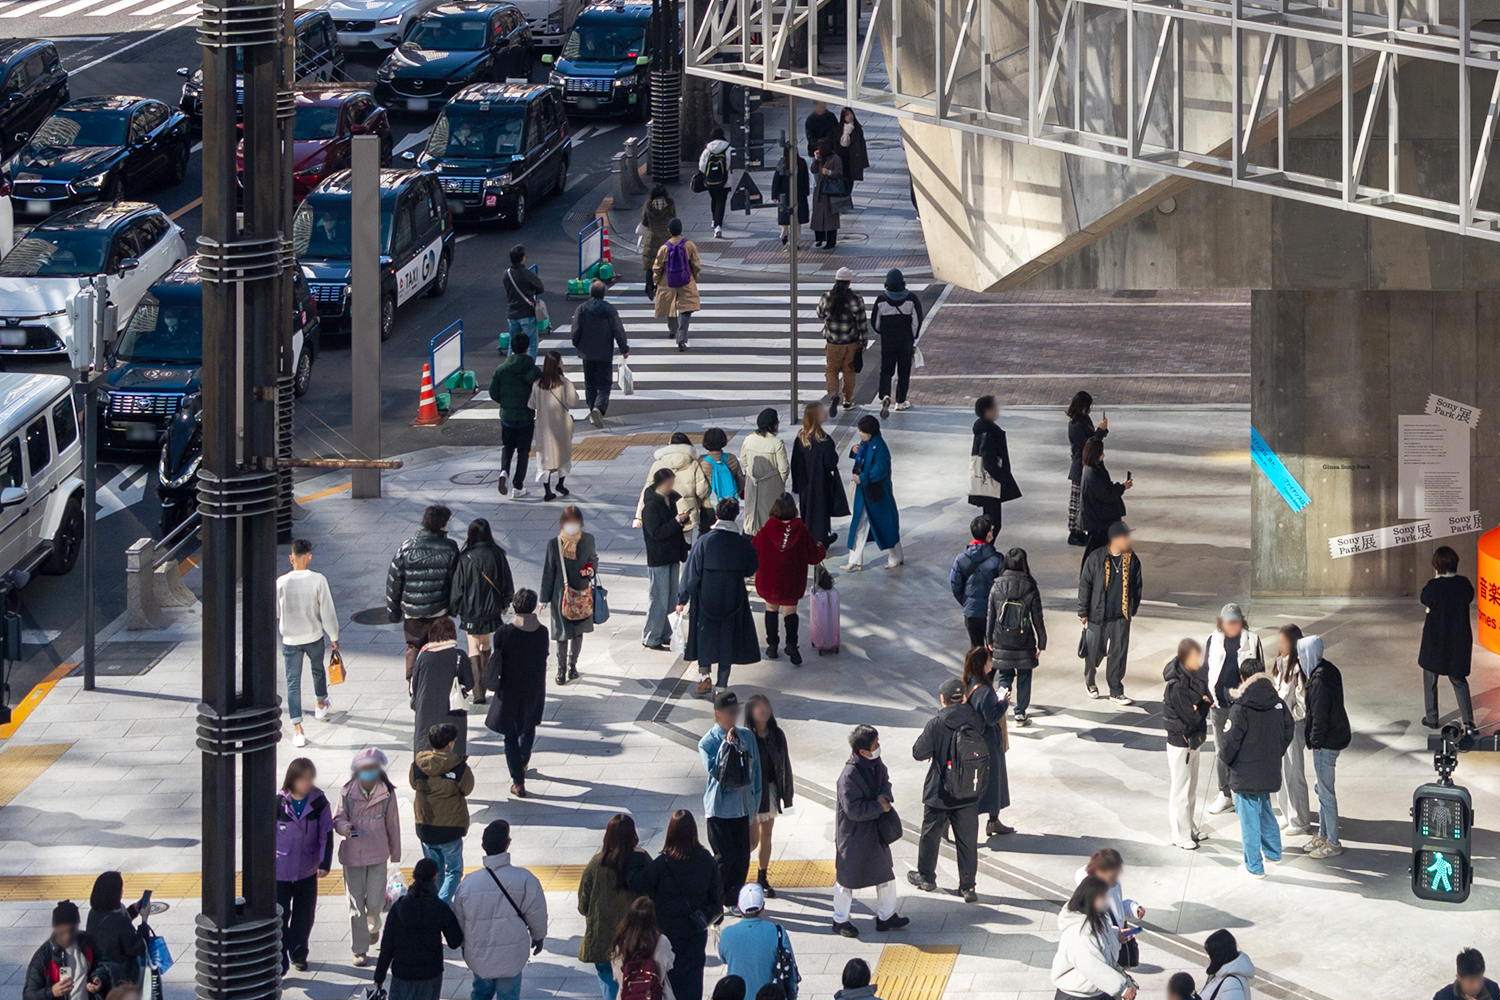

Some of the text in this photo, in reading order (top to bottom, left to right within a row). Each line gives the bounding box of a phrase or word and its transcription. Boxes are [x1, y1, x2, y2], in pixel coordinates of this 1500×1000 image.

[405, 266, 419, 289] TAXI
[1437, 398, 1458, 412] Sony
[1434, 406, 1455, 420] Park
[1449, 514, 1472, 526] Sony
[1393, 525, 1416, 537] Sony
[1450, 525, 1473, 534] Park
[1337, 537, 1360, 547] Sony
[1339, 534, 1377, 555] Park 展
[1395, 535, 1417, 545] Park
